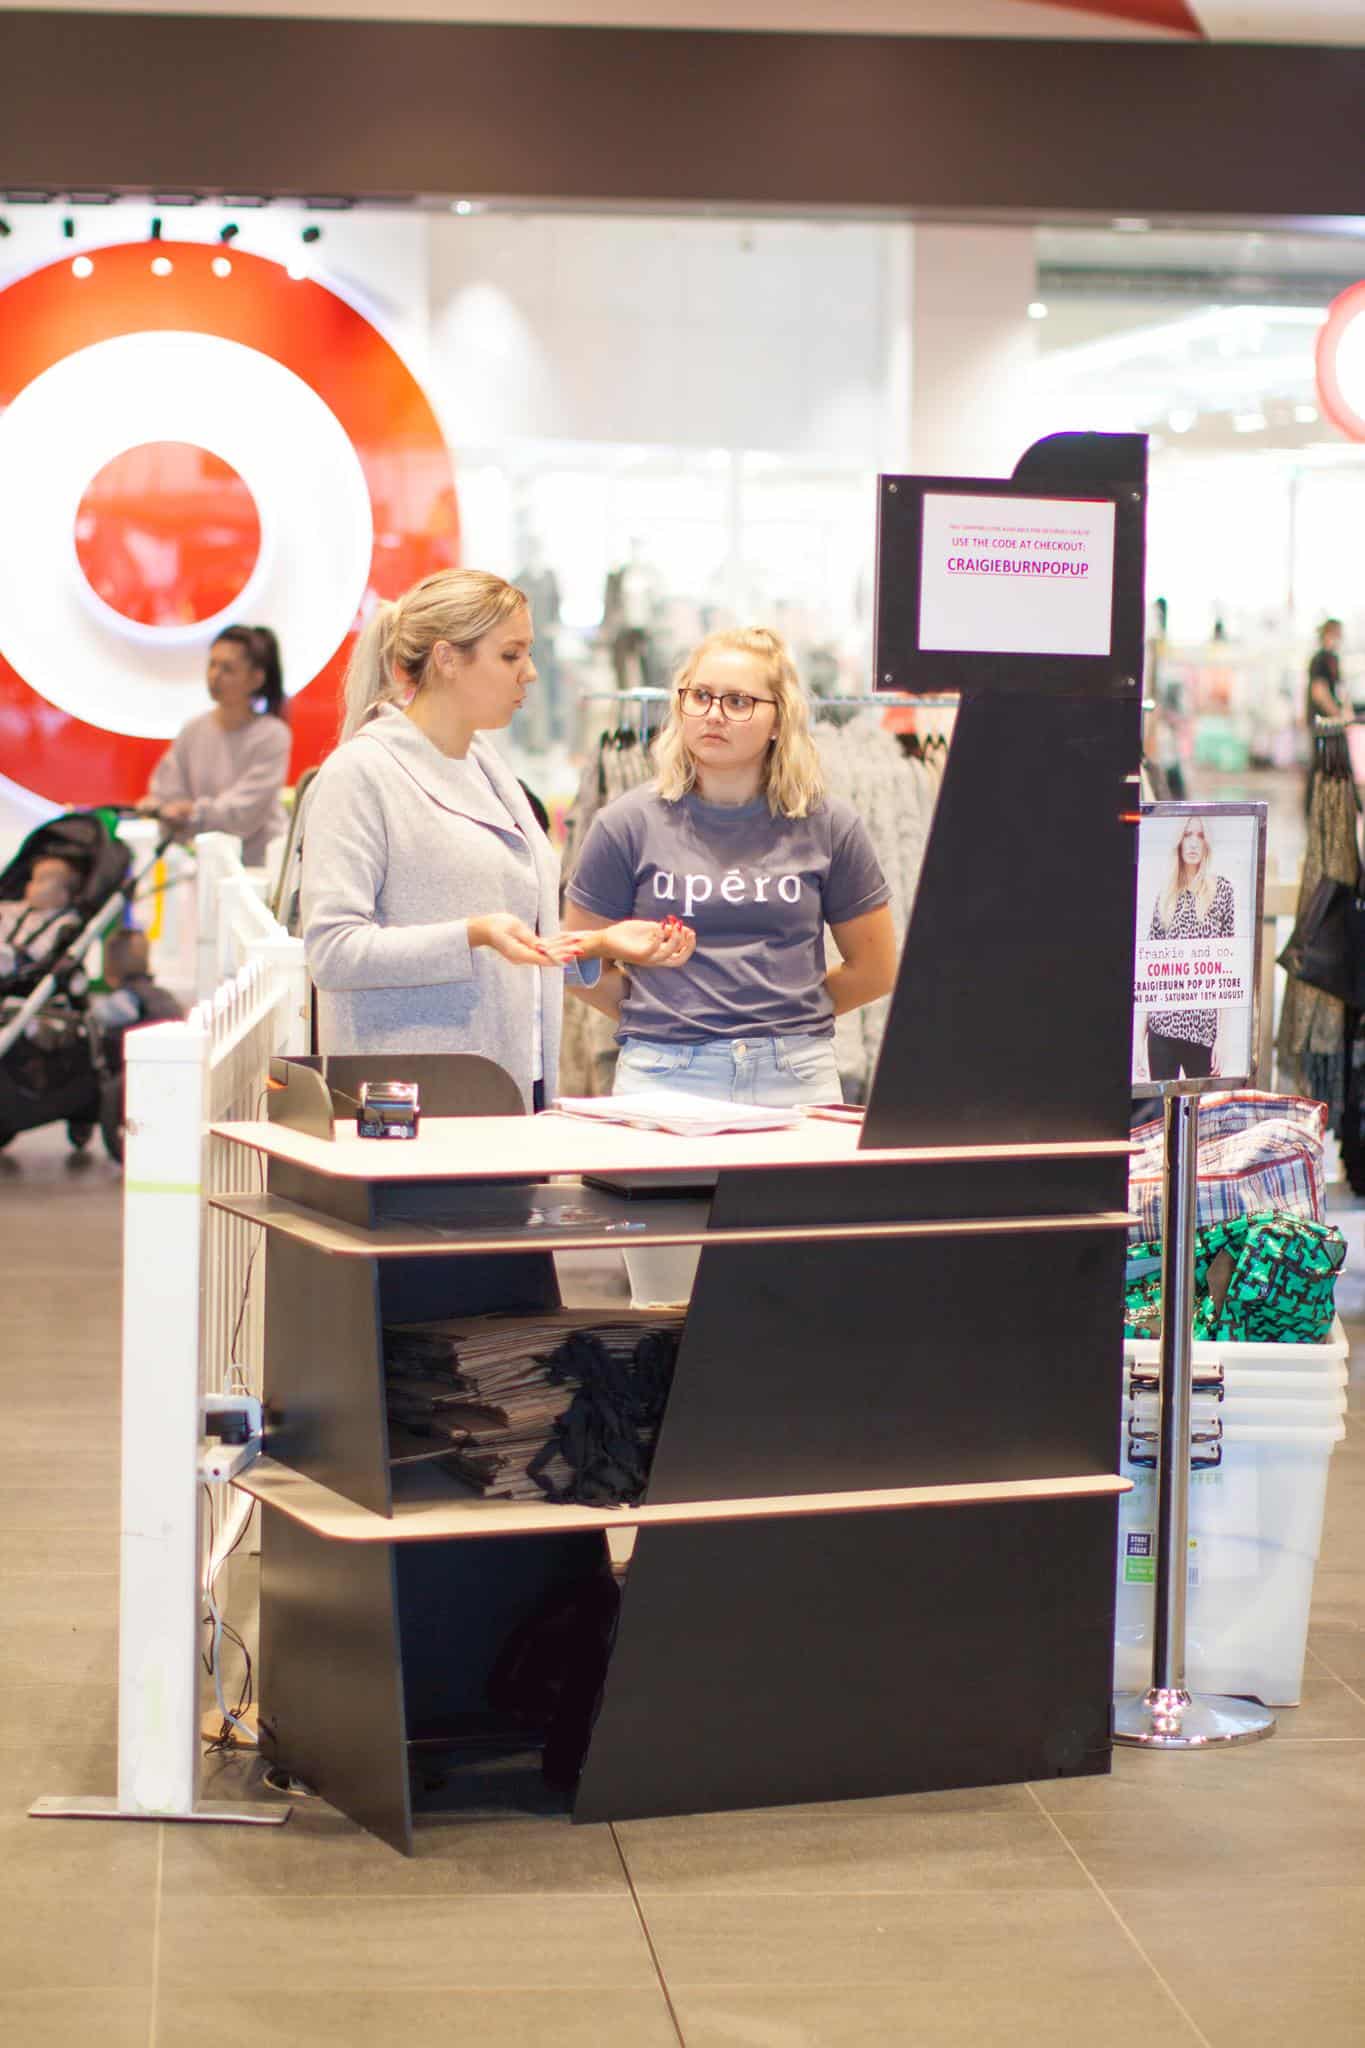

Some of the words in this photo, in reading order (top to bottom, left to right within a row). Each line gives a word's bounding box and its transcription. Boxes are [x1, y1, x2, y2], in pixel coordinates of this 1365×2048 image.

[952, 537, 968, 547] USE
[973, 538, 988, 548] THE
[992, 538, 1017, 549] CODE
[1020, 540, 1031, 550] AT
[1034, 540, 1086, 552] CHECKOUT:
[947, 557, 1089, 576] CRAIGIEBURNPOPUP
[653, 868, 801, 916] apéro
[1192, 944, 1210, 958] and
[1147, 962, 1190, 977] COMING
[1194, 961, 1233, 976] SOON...
[1187, 979, 1202, 989] POP
[1205, 979, 1215, 988] UP
[1218, 978, 1240, 988] STORE
[1145, 994, 1157, 1003] DAY
[1165, 993, 1197, 1002] SATURDAY
[1219, 990, 1244, 1000] AUGUST
[1191, 1472, 1224, 1484] FFER
